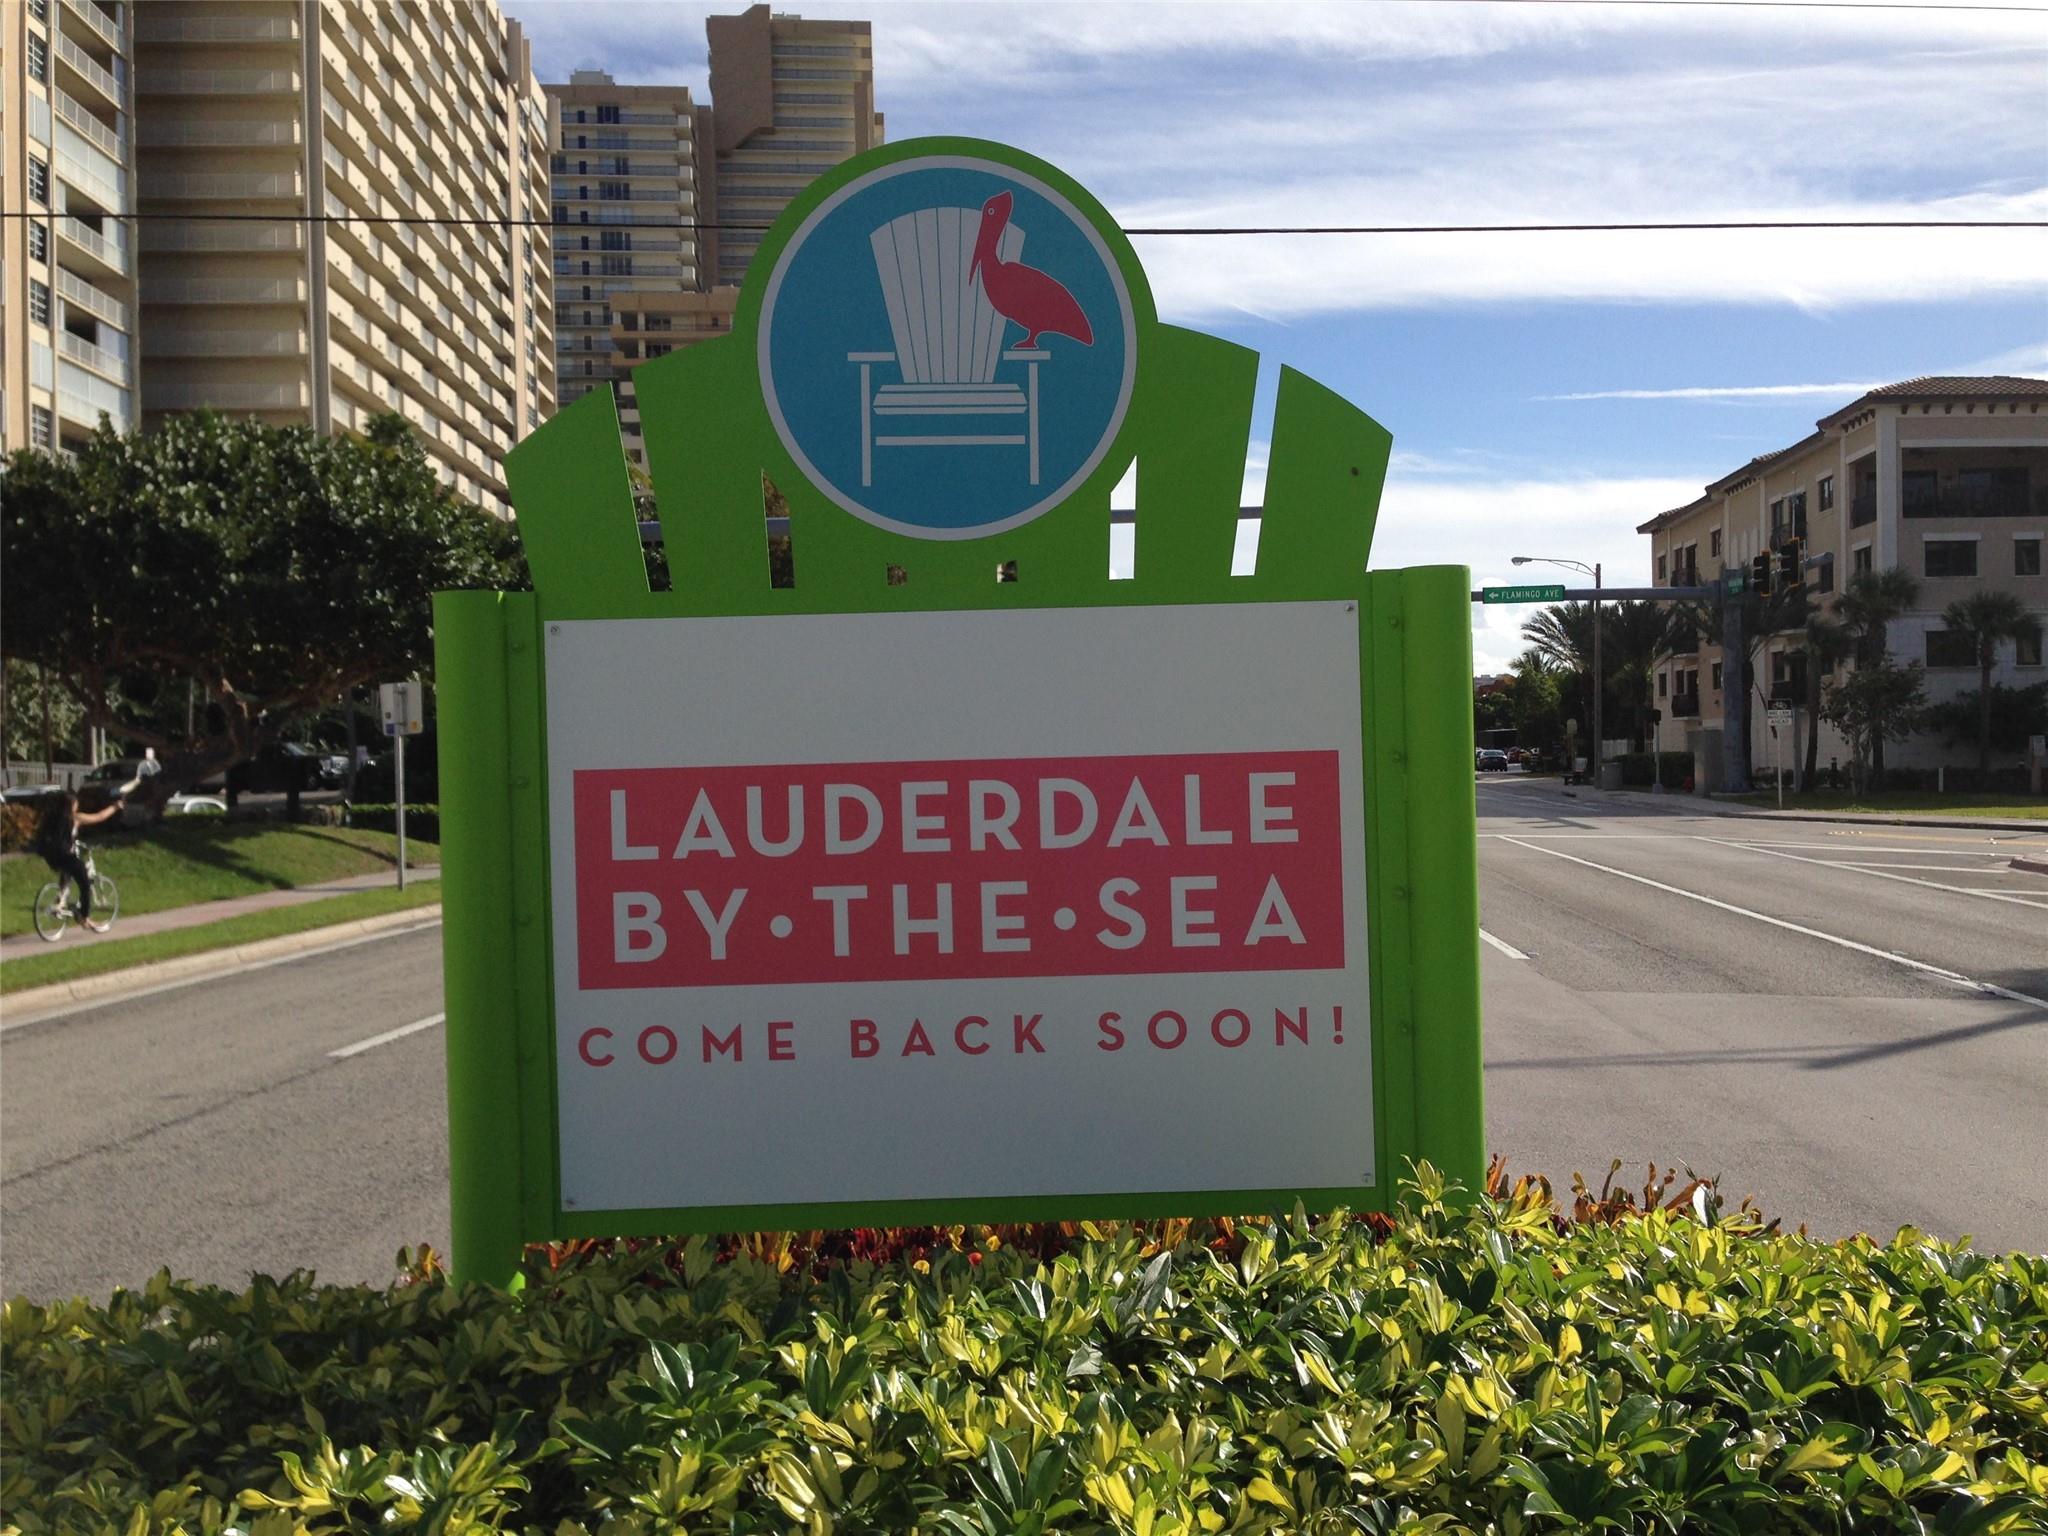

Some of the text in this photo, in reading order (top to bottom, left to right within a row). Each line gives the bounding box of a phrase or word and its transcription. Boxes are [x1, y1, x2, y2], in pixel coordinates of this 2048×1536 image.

[1501, 589, 1559, 600] FLAMINGO AVE
[611, 771, 1300, 861] LAUDERDALE
[578, 1007, 1345, 1067] COME BACK SOON!
